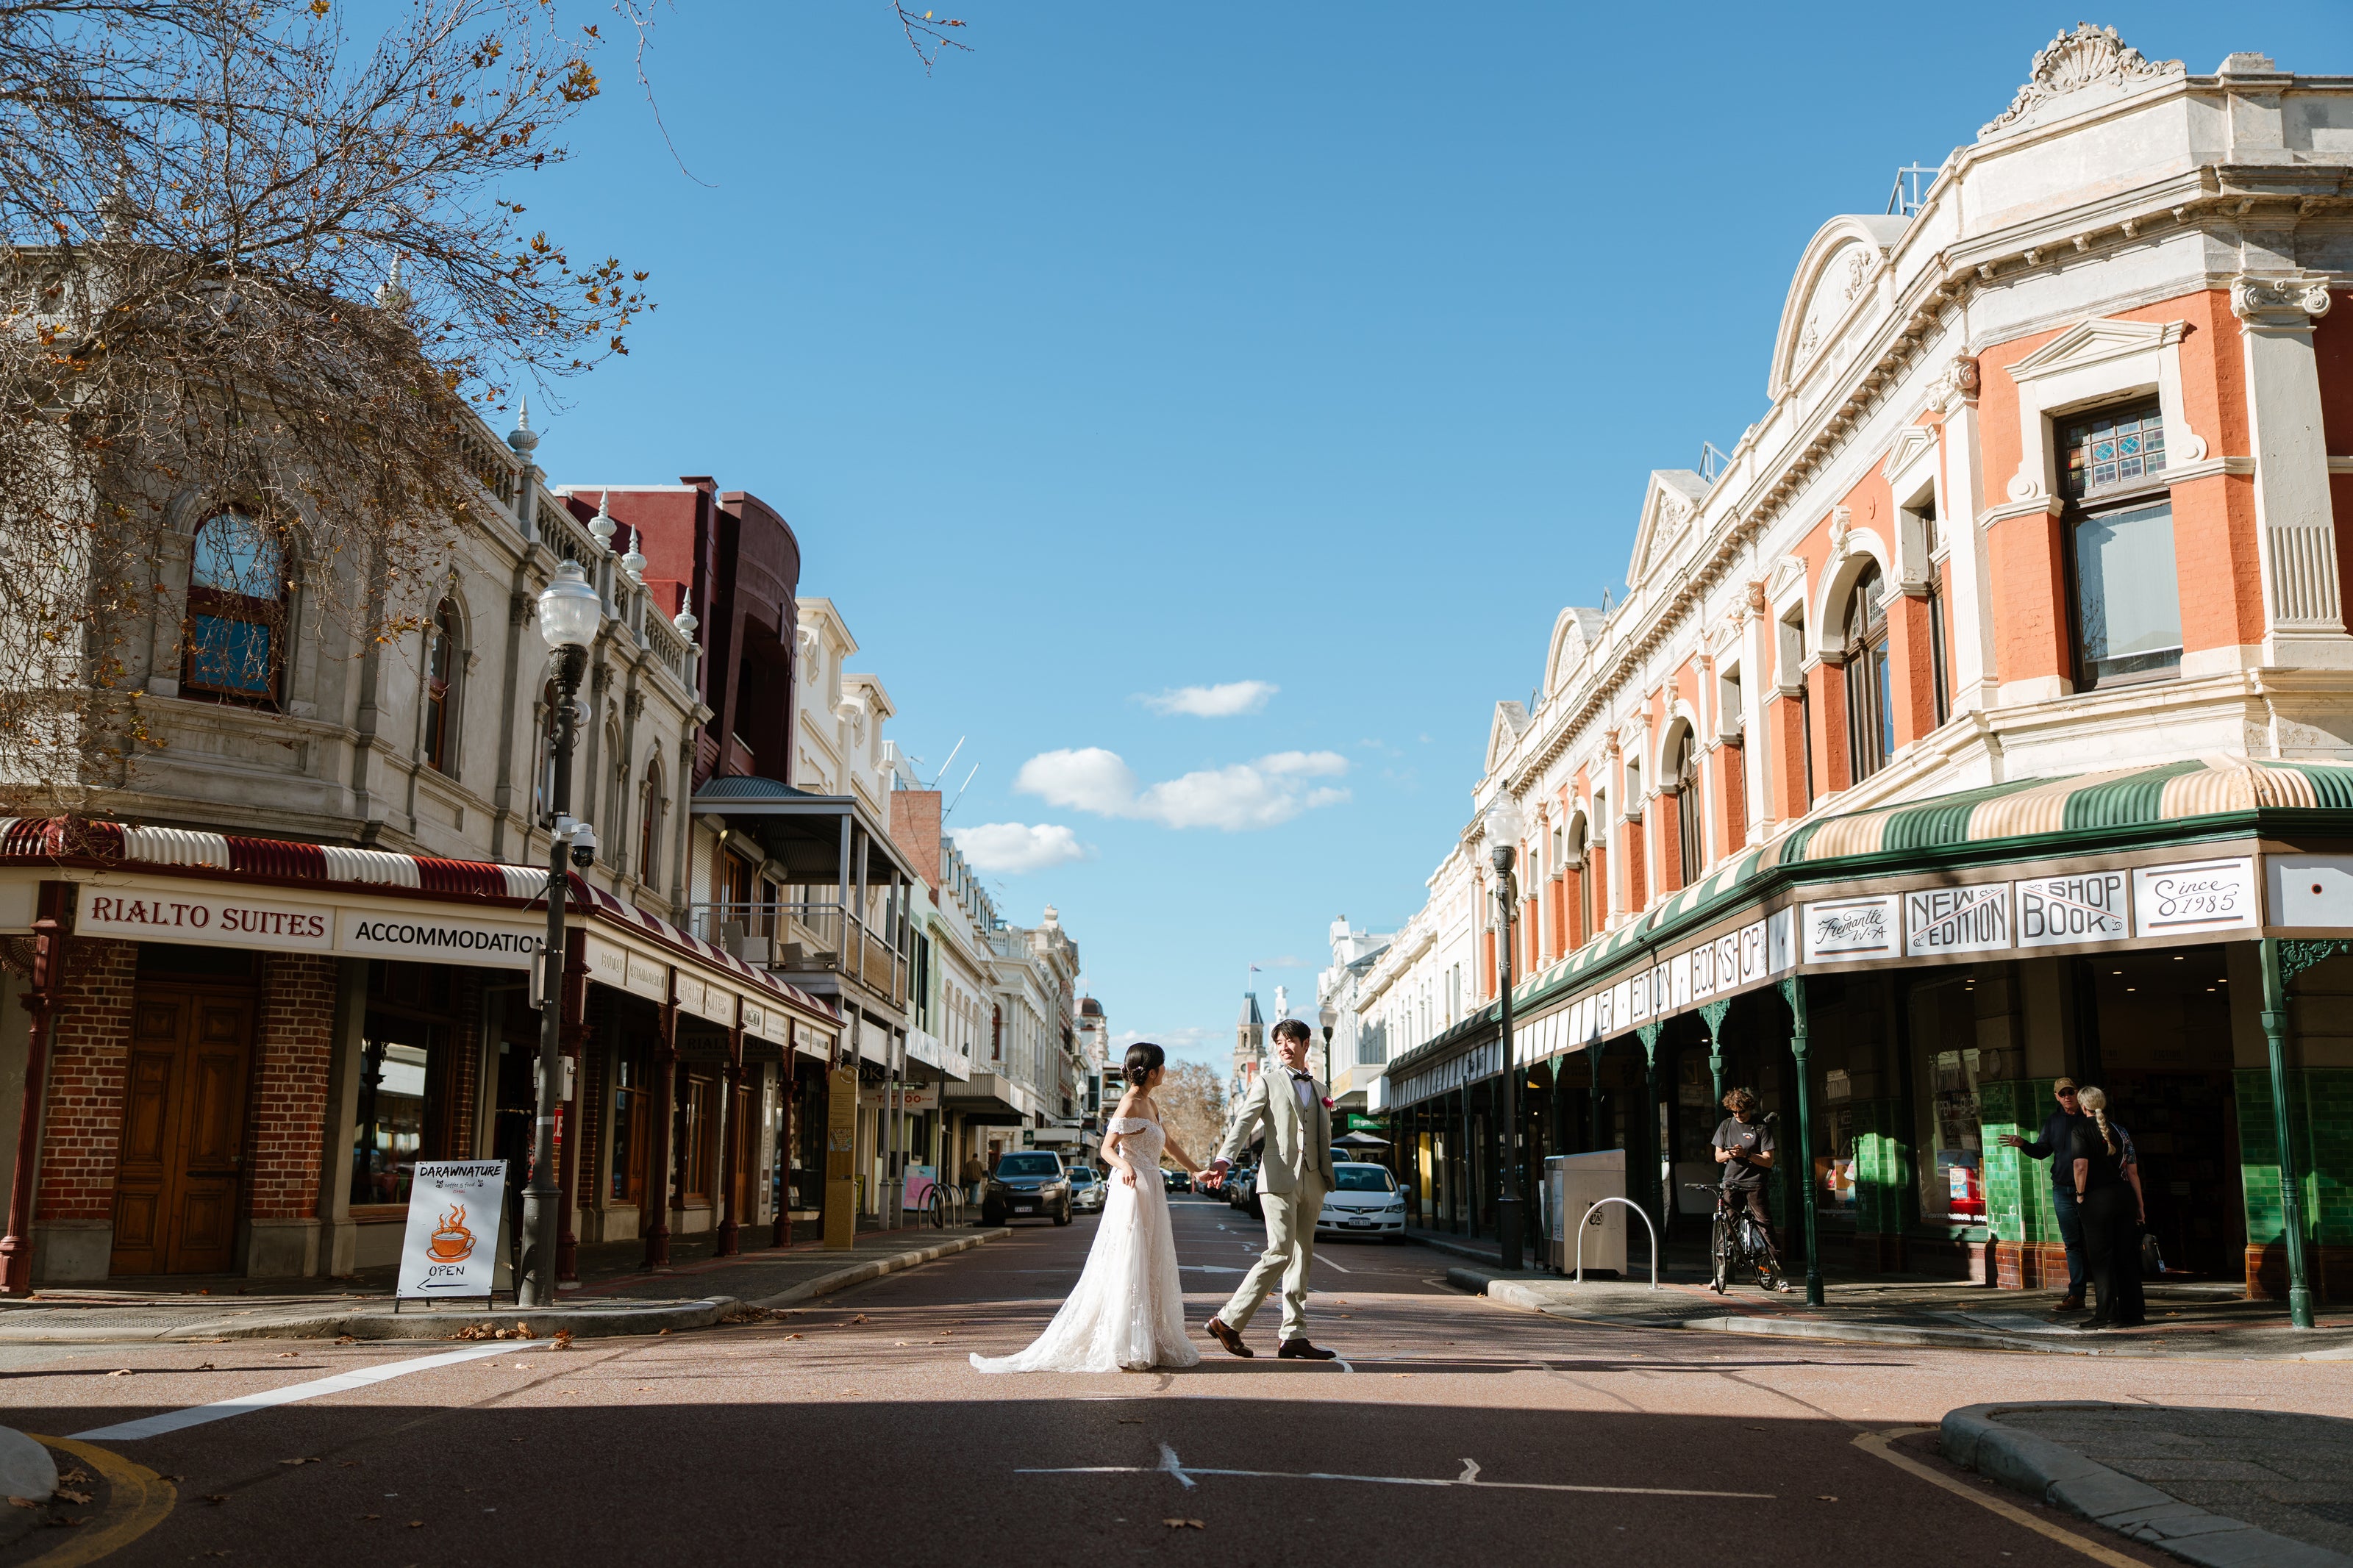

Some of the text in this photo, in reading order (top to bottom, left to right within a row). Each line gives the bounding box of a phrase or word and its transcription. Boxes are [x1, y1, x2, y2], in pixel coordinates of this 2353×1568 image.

[1912, 889, 1974, 933] NEW
[2049, 876, 2121, 912] SHOP
[2155, 879, 2239, 917] Since
[2179, 891, 2237, 914] 1985
[91, 897, 325, 939] RIALTO SUITES
[1815, 909, 1888, 945] Fremantle
[1929, 892, 2006, 946] EDITION
[2023, 892, 2106, 939] BOOK
[355, 921, 543, 953] ACCOMMODATIO
[601, 952, 624, 974] BOUTIQUE
[1633, 965, 1670, 1017] EDITION
[1695, 926, 1760, 994] BOOKSHOP
[680, 978, 726, 1014] RIALTO SUITES
[688, 1037, 729, 1050] RIALT
[876, 1095, 921, 1103] TTOO
[553, 1115, 563, 1136] LE
[420, 1165, 502, 1178] DARAWNATURE
[429, 1265, 465, 1277] OPEN
